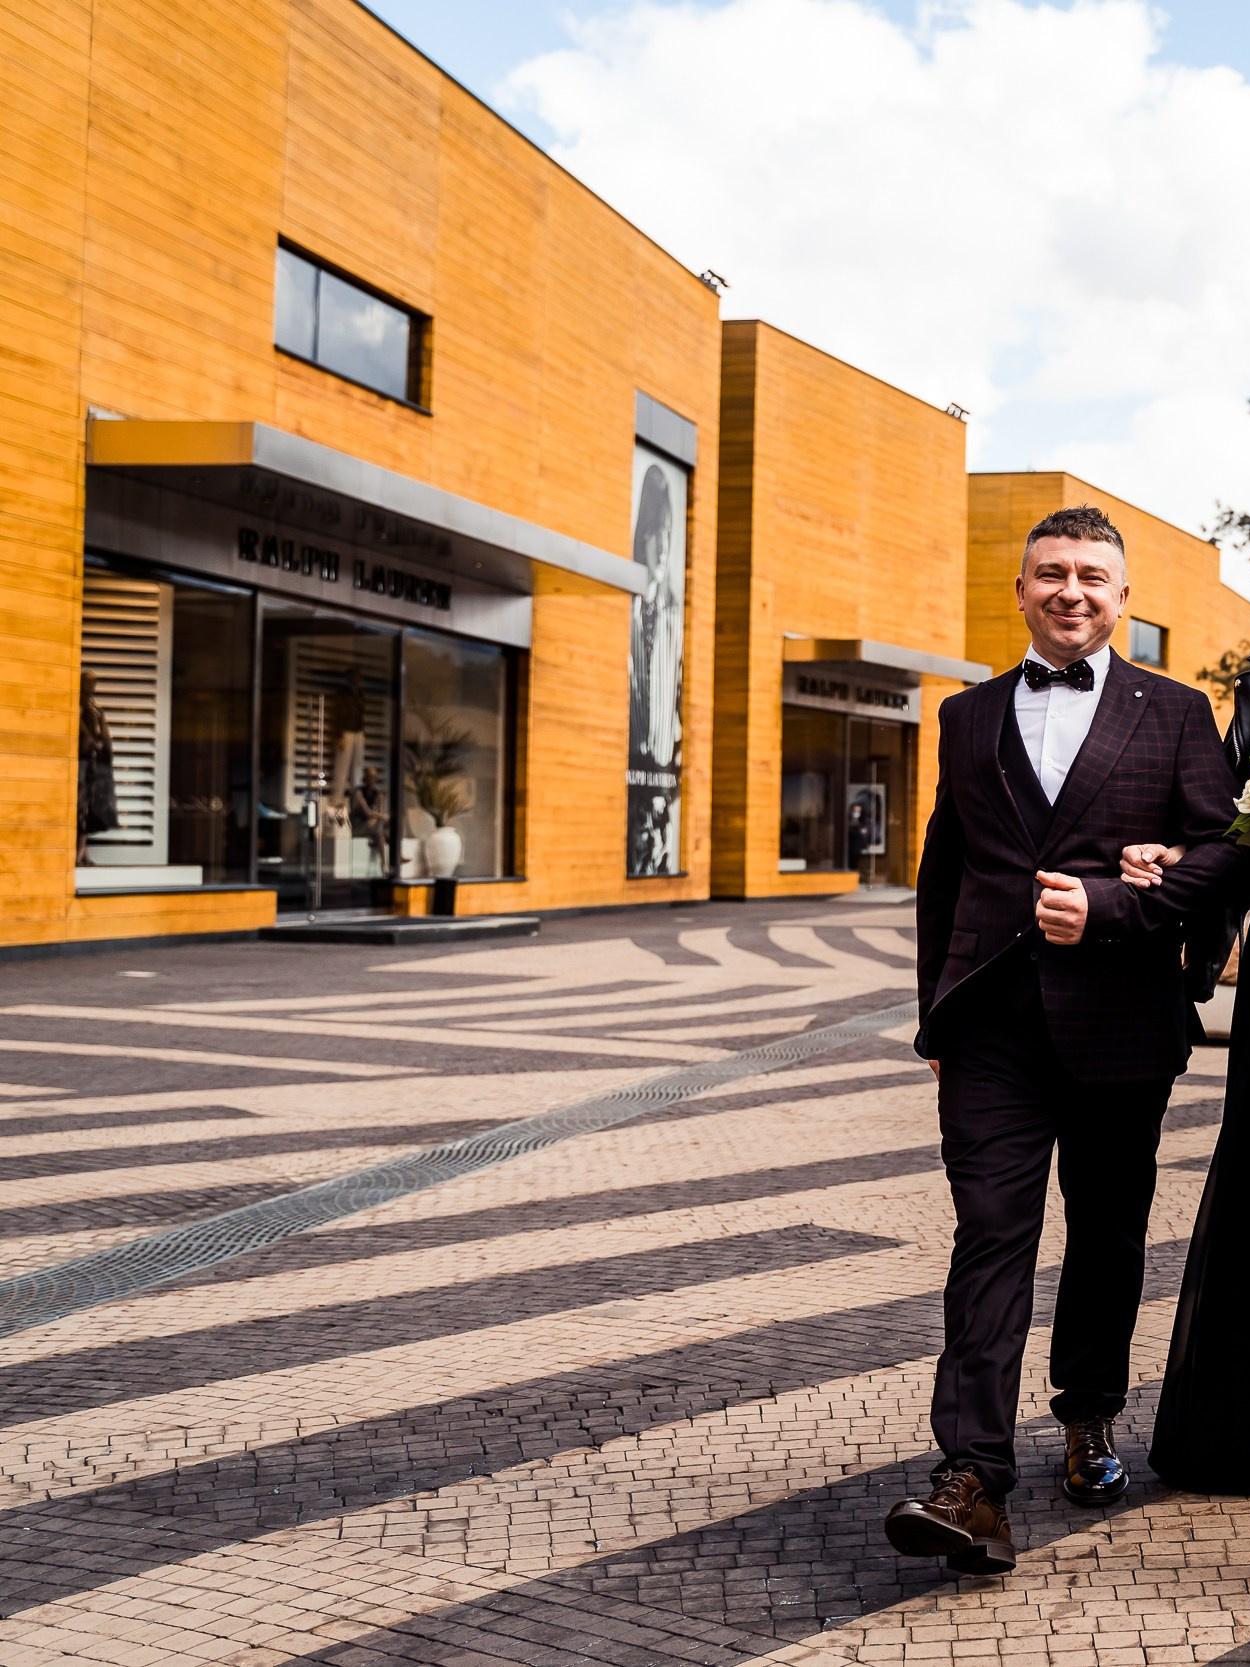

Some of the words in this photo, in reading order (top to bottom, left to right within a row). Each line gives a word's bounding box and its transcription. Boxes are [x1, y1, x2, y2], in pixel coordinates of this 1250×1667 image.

[237, 526, 340, 583] RALPH
[352, 558, 452, 611] LAUREN
[796, 674, 849, 701] RALPH
